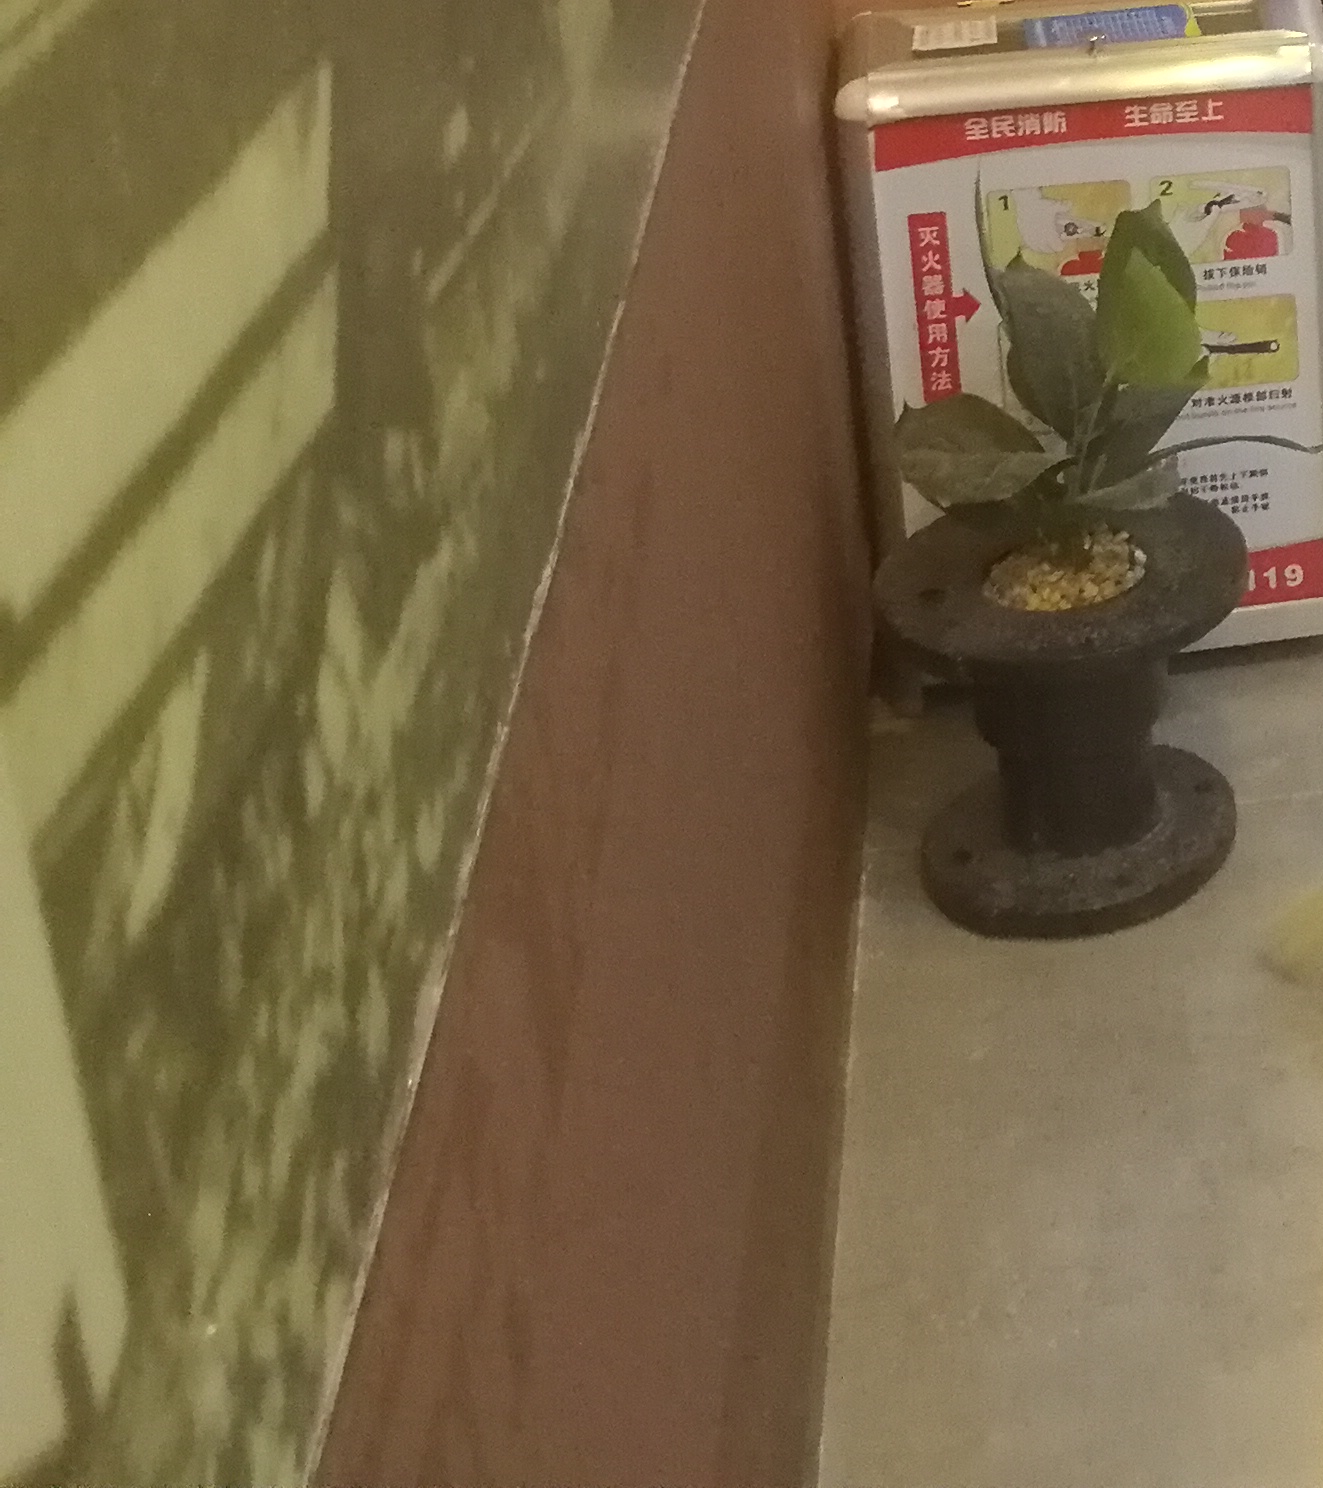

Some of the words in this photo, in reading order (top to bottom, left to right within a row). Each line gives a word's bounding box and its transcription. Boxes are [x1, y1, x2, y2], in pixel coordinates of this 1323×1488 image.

[964, 110, 1068, 141] 全民消防
[1124, 98, 1225, 129] 生命至上
[1159, 180, 1174, 197] 2
[917, 225, 954, 392] 灭火器使用方法
